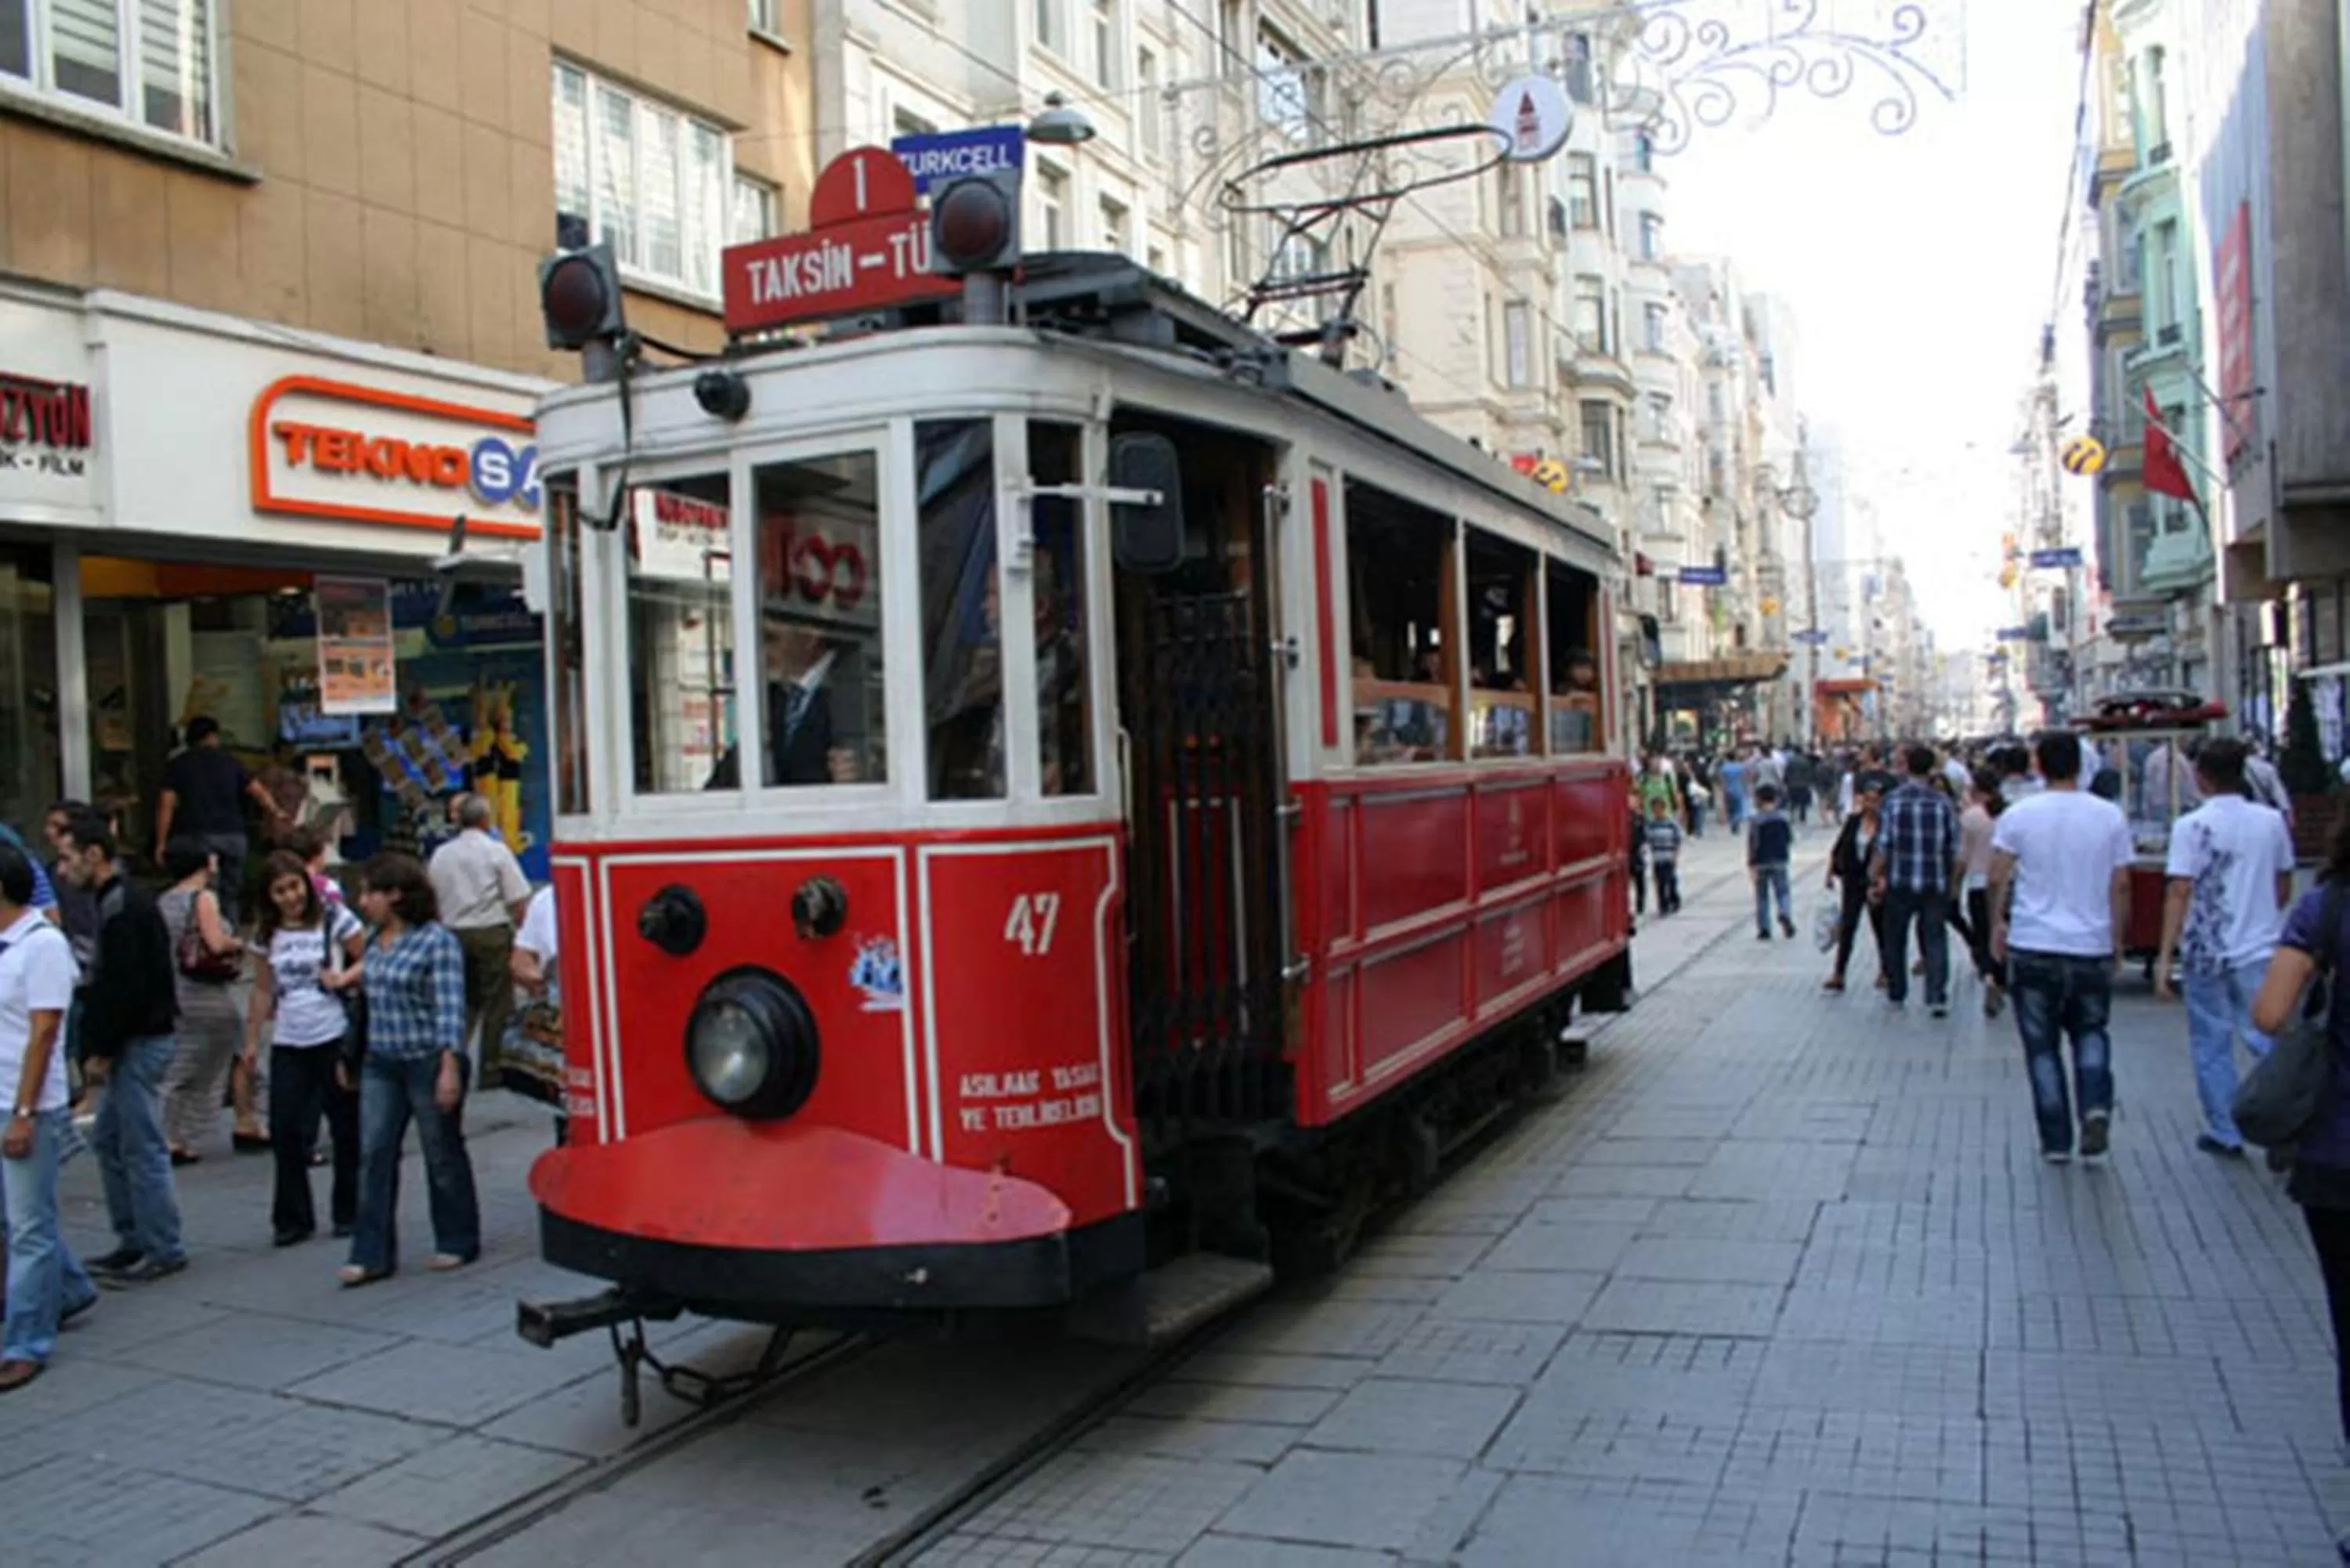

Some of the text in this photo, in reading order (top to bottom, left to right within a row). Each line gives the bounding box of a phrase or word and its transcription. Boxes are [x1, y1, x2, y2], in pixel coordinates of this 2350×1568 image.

[851, 157, 867, 211] 1
[898, 144, 1013, 177] TURKCELL
[0, 384, 91, 449] ZYON
[1004, 891, 1060, 955] 47
